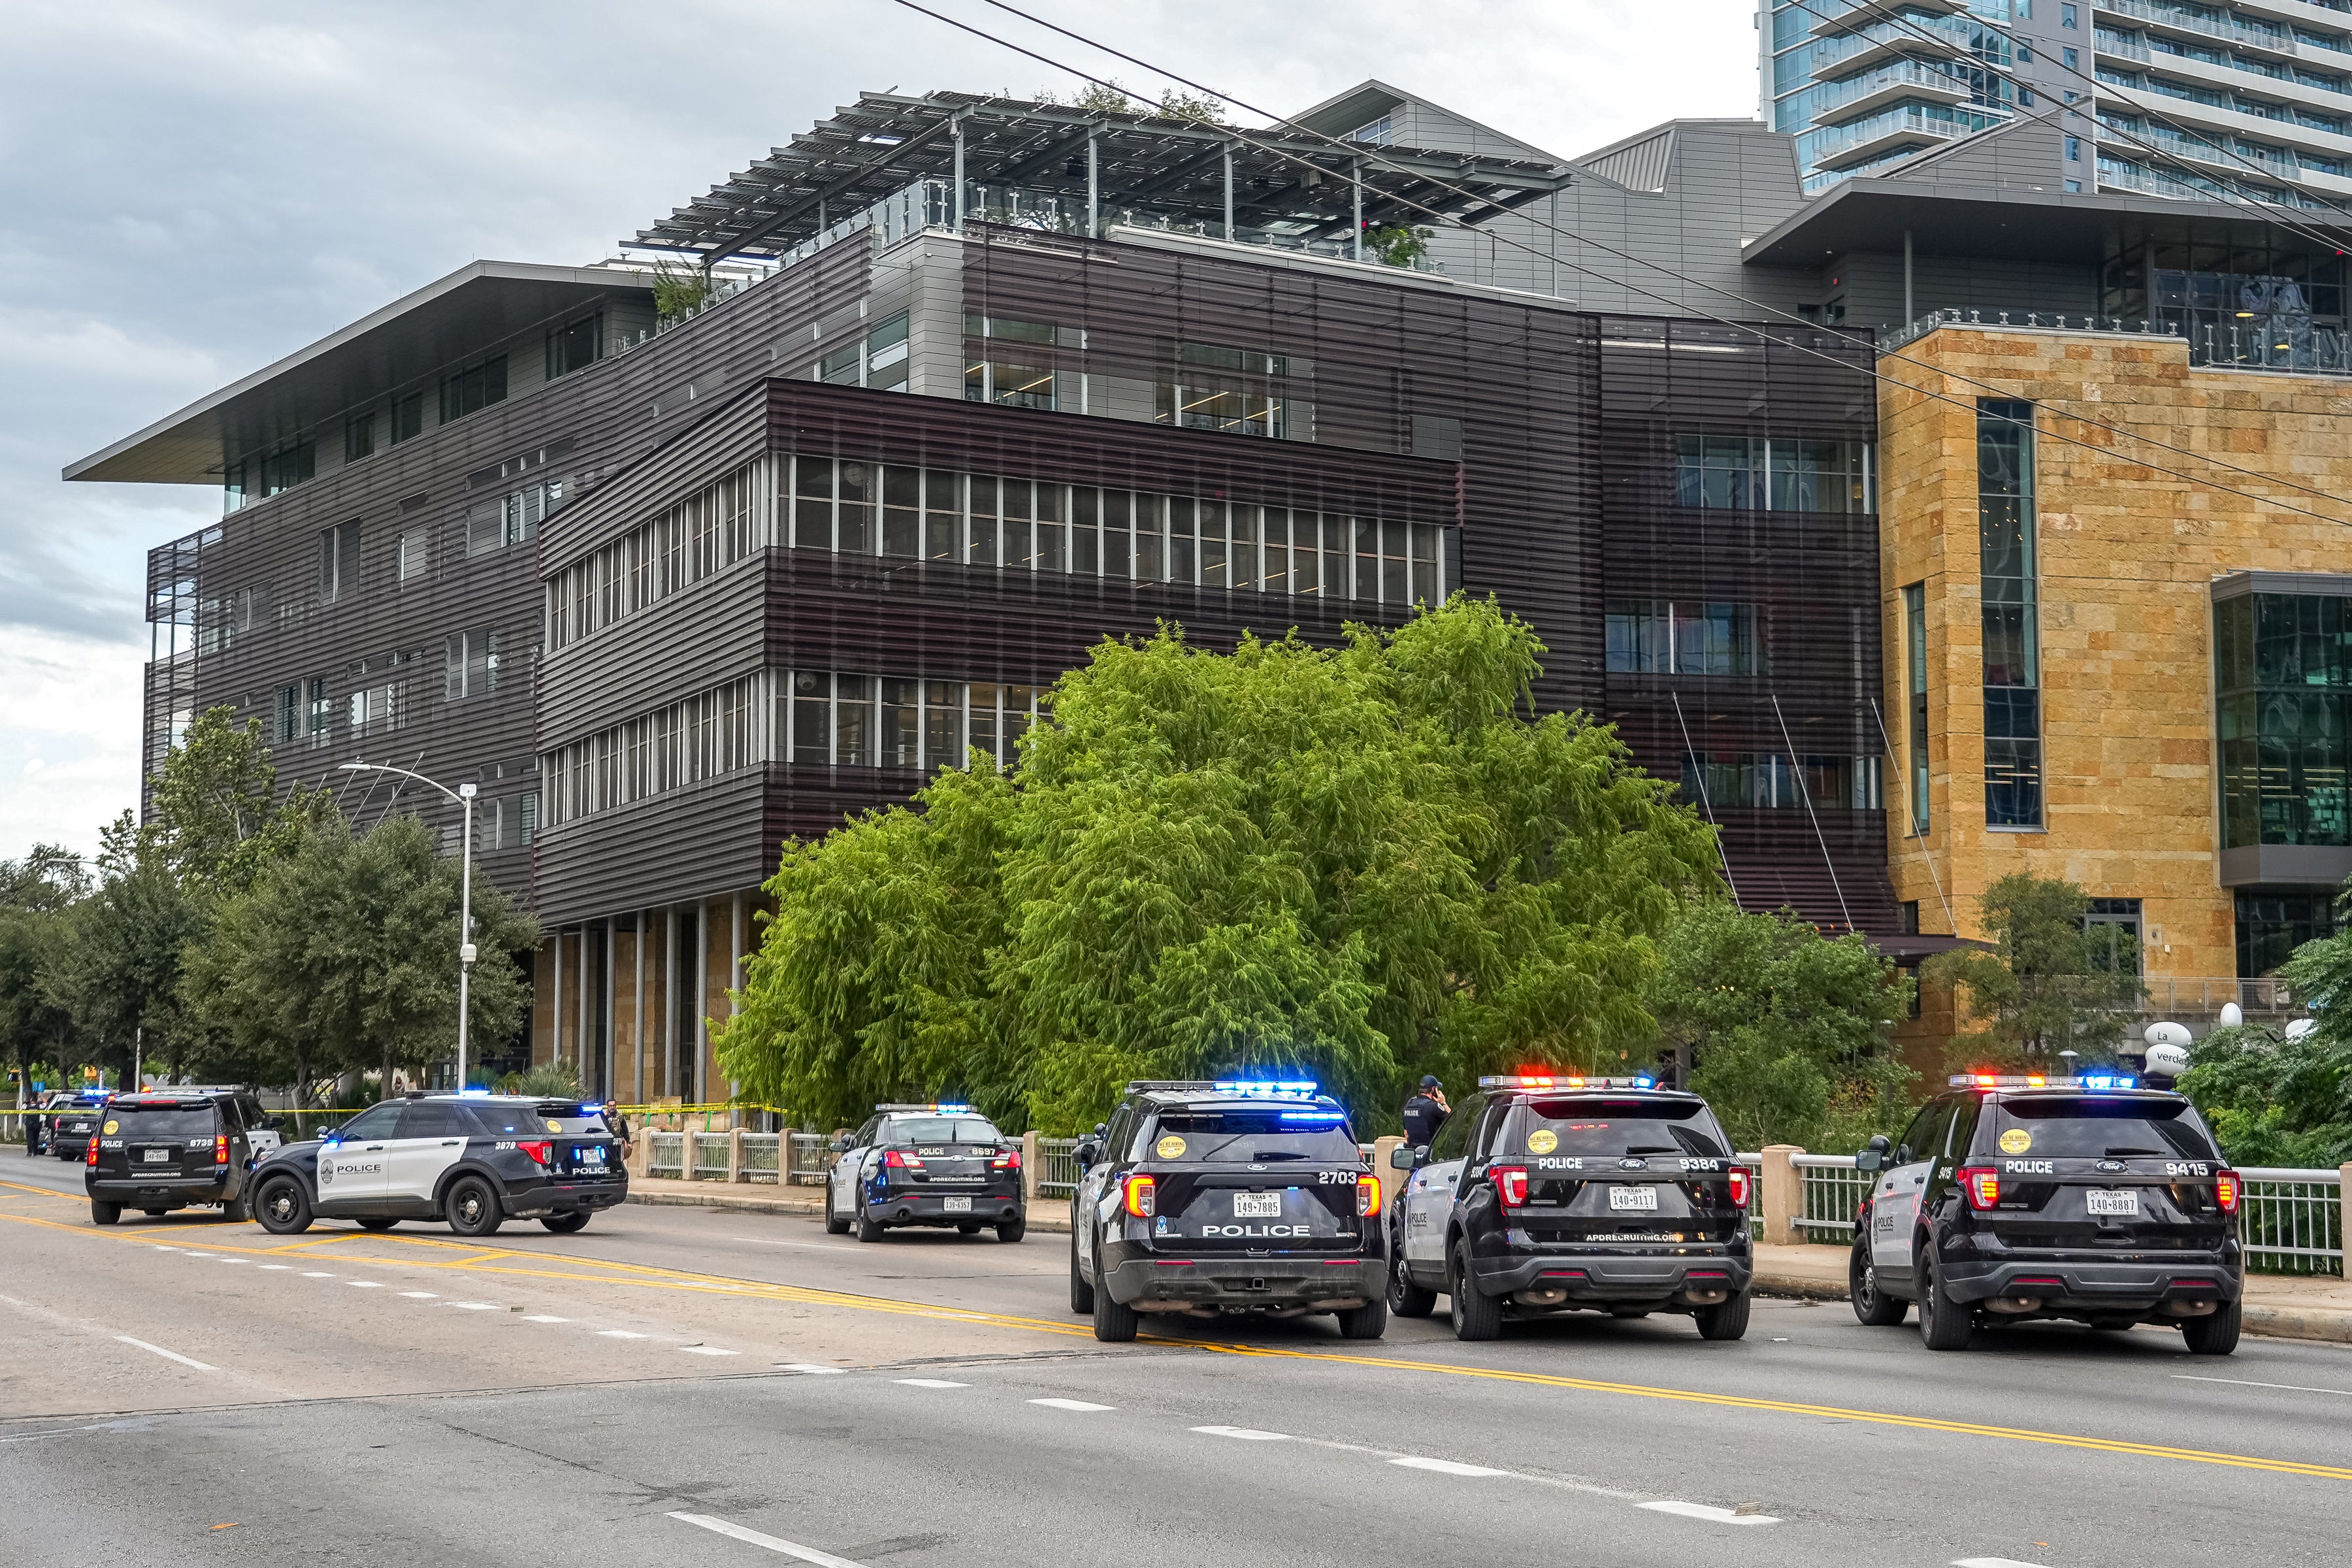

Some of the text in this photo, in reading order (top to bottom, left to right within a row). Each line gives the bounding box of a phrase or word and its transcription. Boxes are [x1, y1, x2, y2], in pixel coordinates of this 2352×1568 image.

[2157, 1031, 2168, 1040] La
[337, 1164, 382, 1173] POLICE
[1539, 1157, 1582, 1170] POLICE
[1678, 1158, 1719, 1171] 9384
[2006, 1160, 2053, 1174] POLICE
[2165, 1162, 2208, 1176] 9415
[572, 1167, 611, 1175] POLICE
[1938, 1167, 1953, 1179] 9415
[1318, 1171, 1357, 1184] 2703
[1411, 1213, 1427, 1223] POLICE
[1878, 1216, 1893, 1228] POLICE
[1202, 1225, 1311, 1237] POLICE
